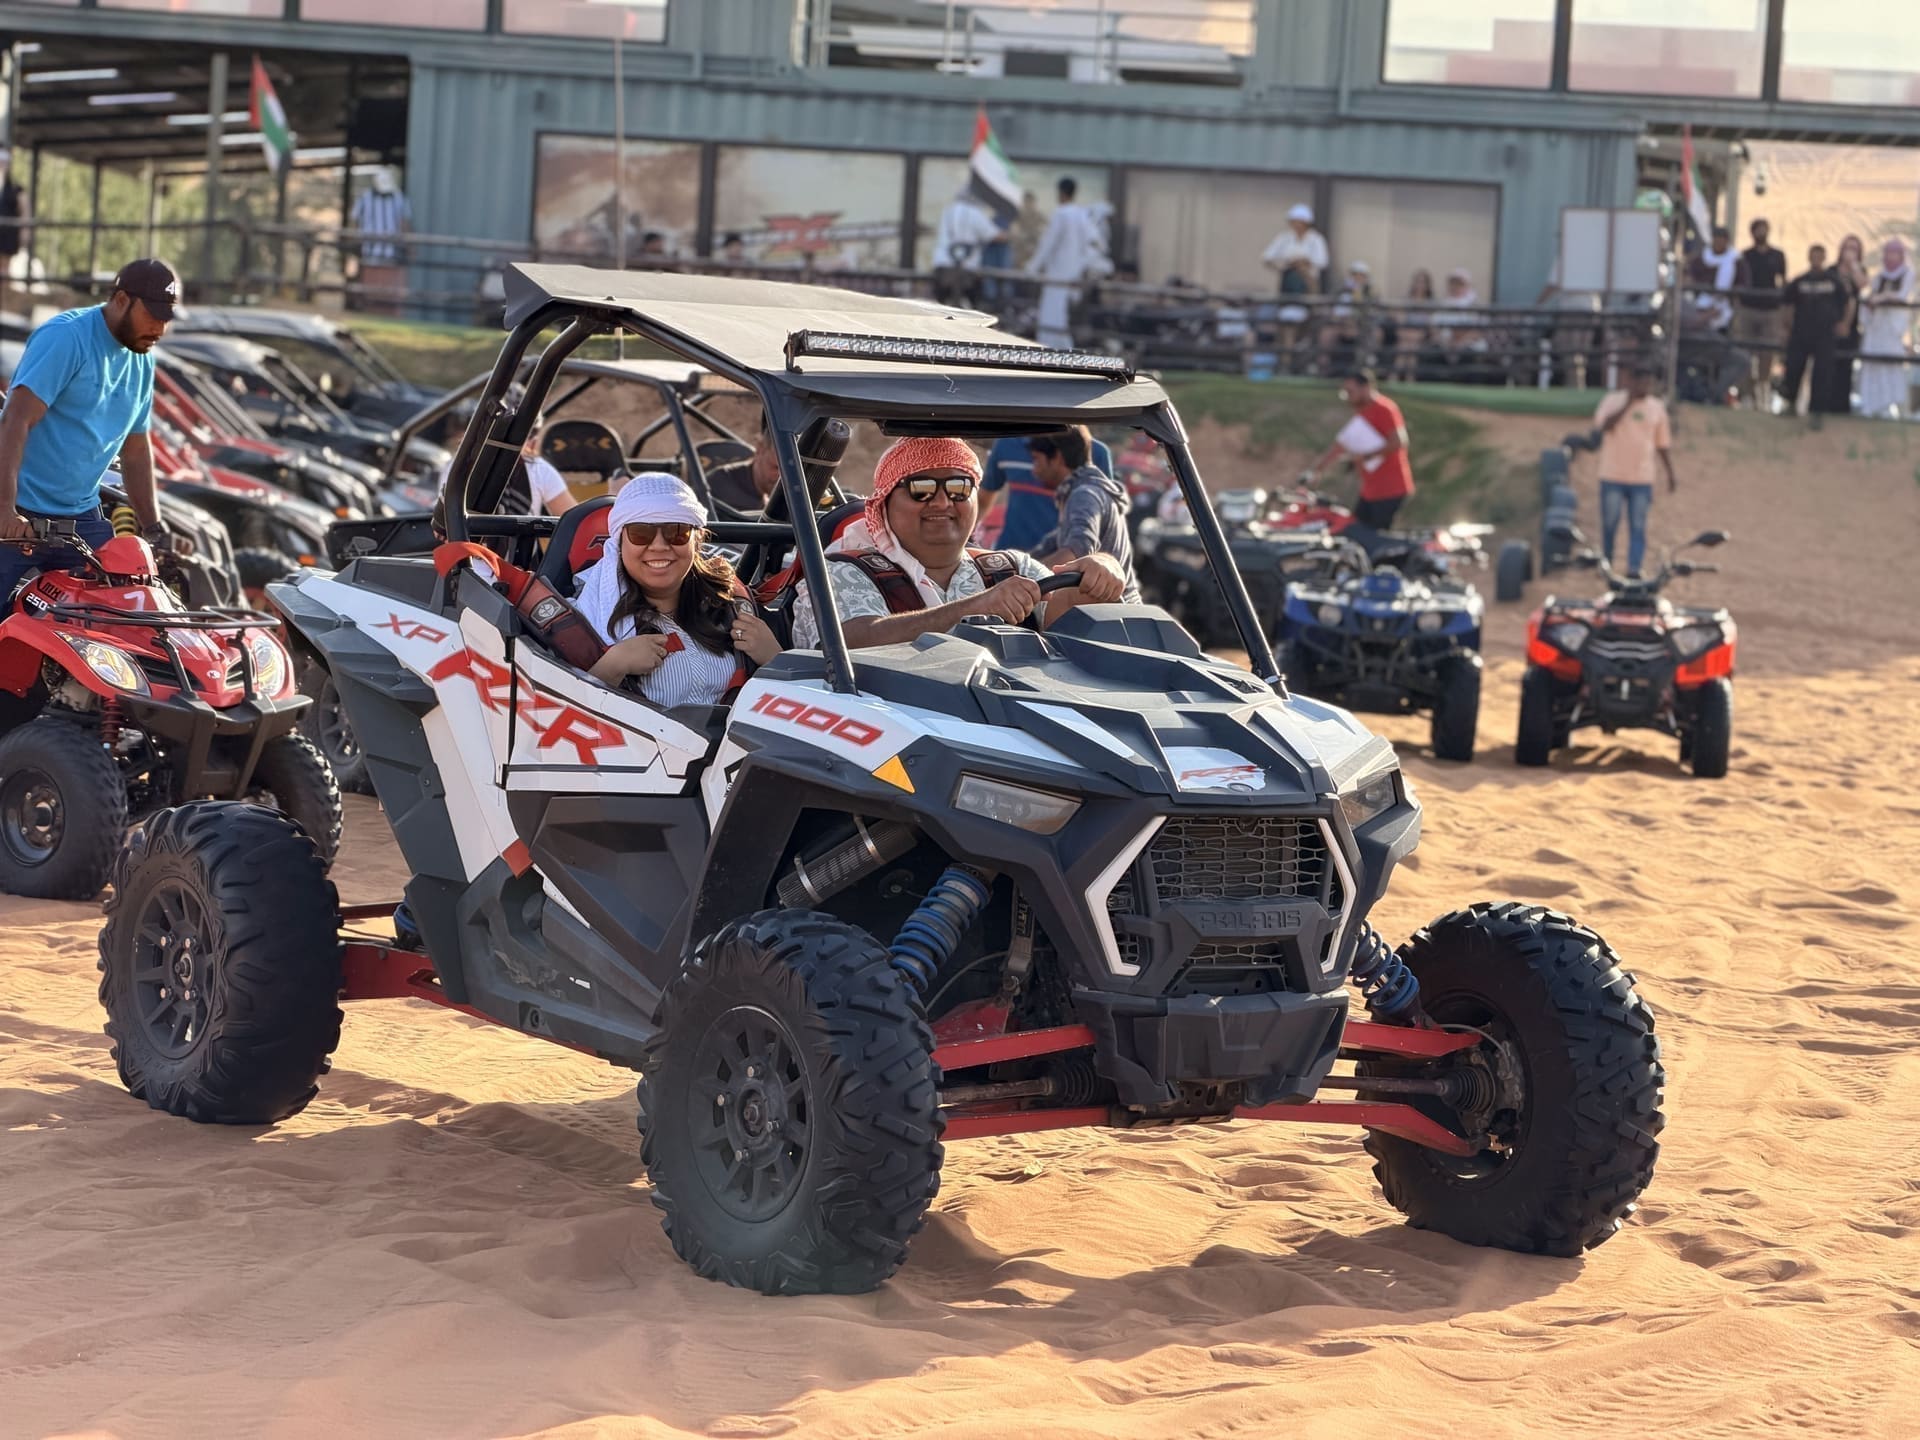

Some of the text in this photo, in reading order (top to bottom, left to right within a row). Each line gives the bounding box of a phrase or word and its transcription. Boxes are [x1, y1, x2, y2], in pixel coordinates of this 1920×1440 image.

[369, 612, 449, 643] XP
[426, 645, 627, 766] RZR
[750, 693, 885, 747] 1000
[1200, 910, 1301, 929] POLARIS
